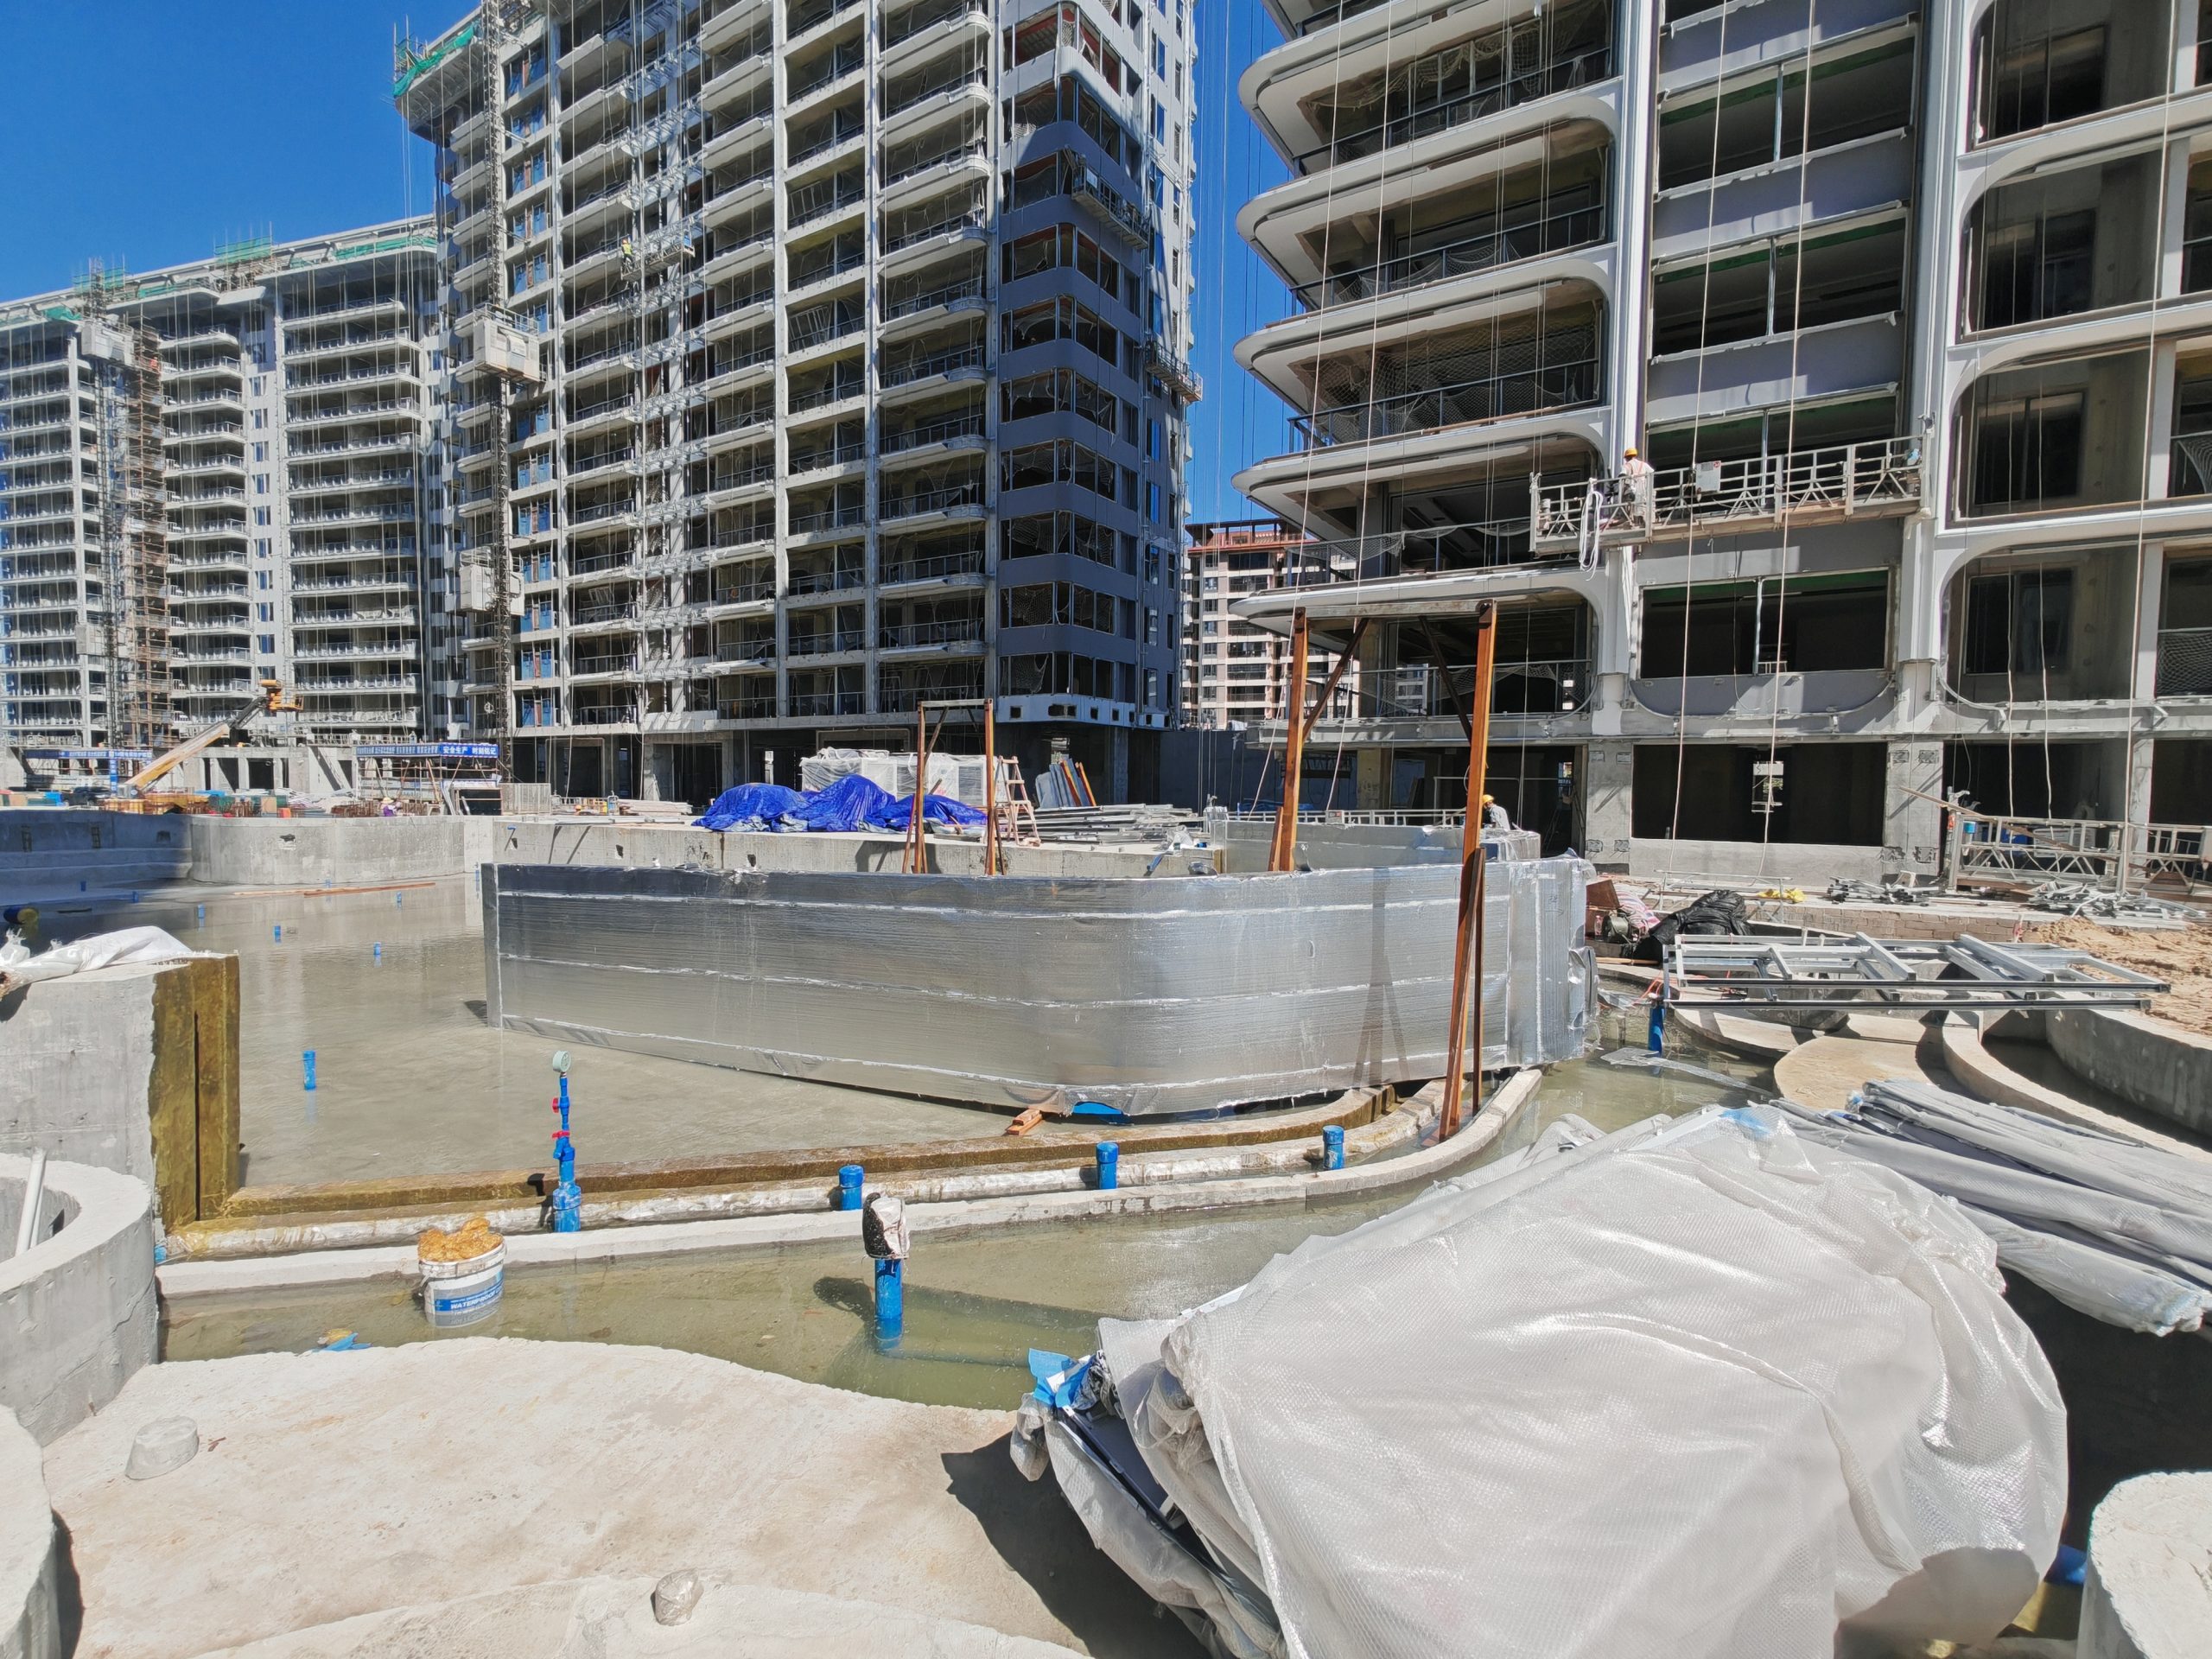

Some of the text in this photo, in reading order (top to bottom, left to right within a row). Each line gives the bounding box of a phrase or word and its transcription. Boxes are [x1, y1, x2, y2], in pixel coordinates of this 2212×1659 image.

[443, 746, 467, 754] 安全生产
[451, 1290, 496, 1309] WATERPROOF
